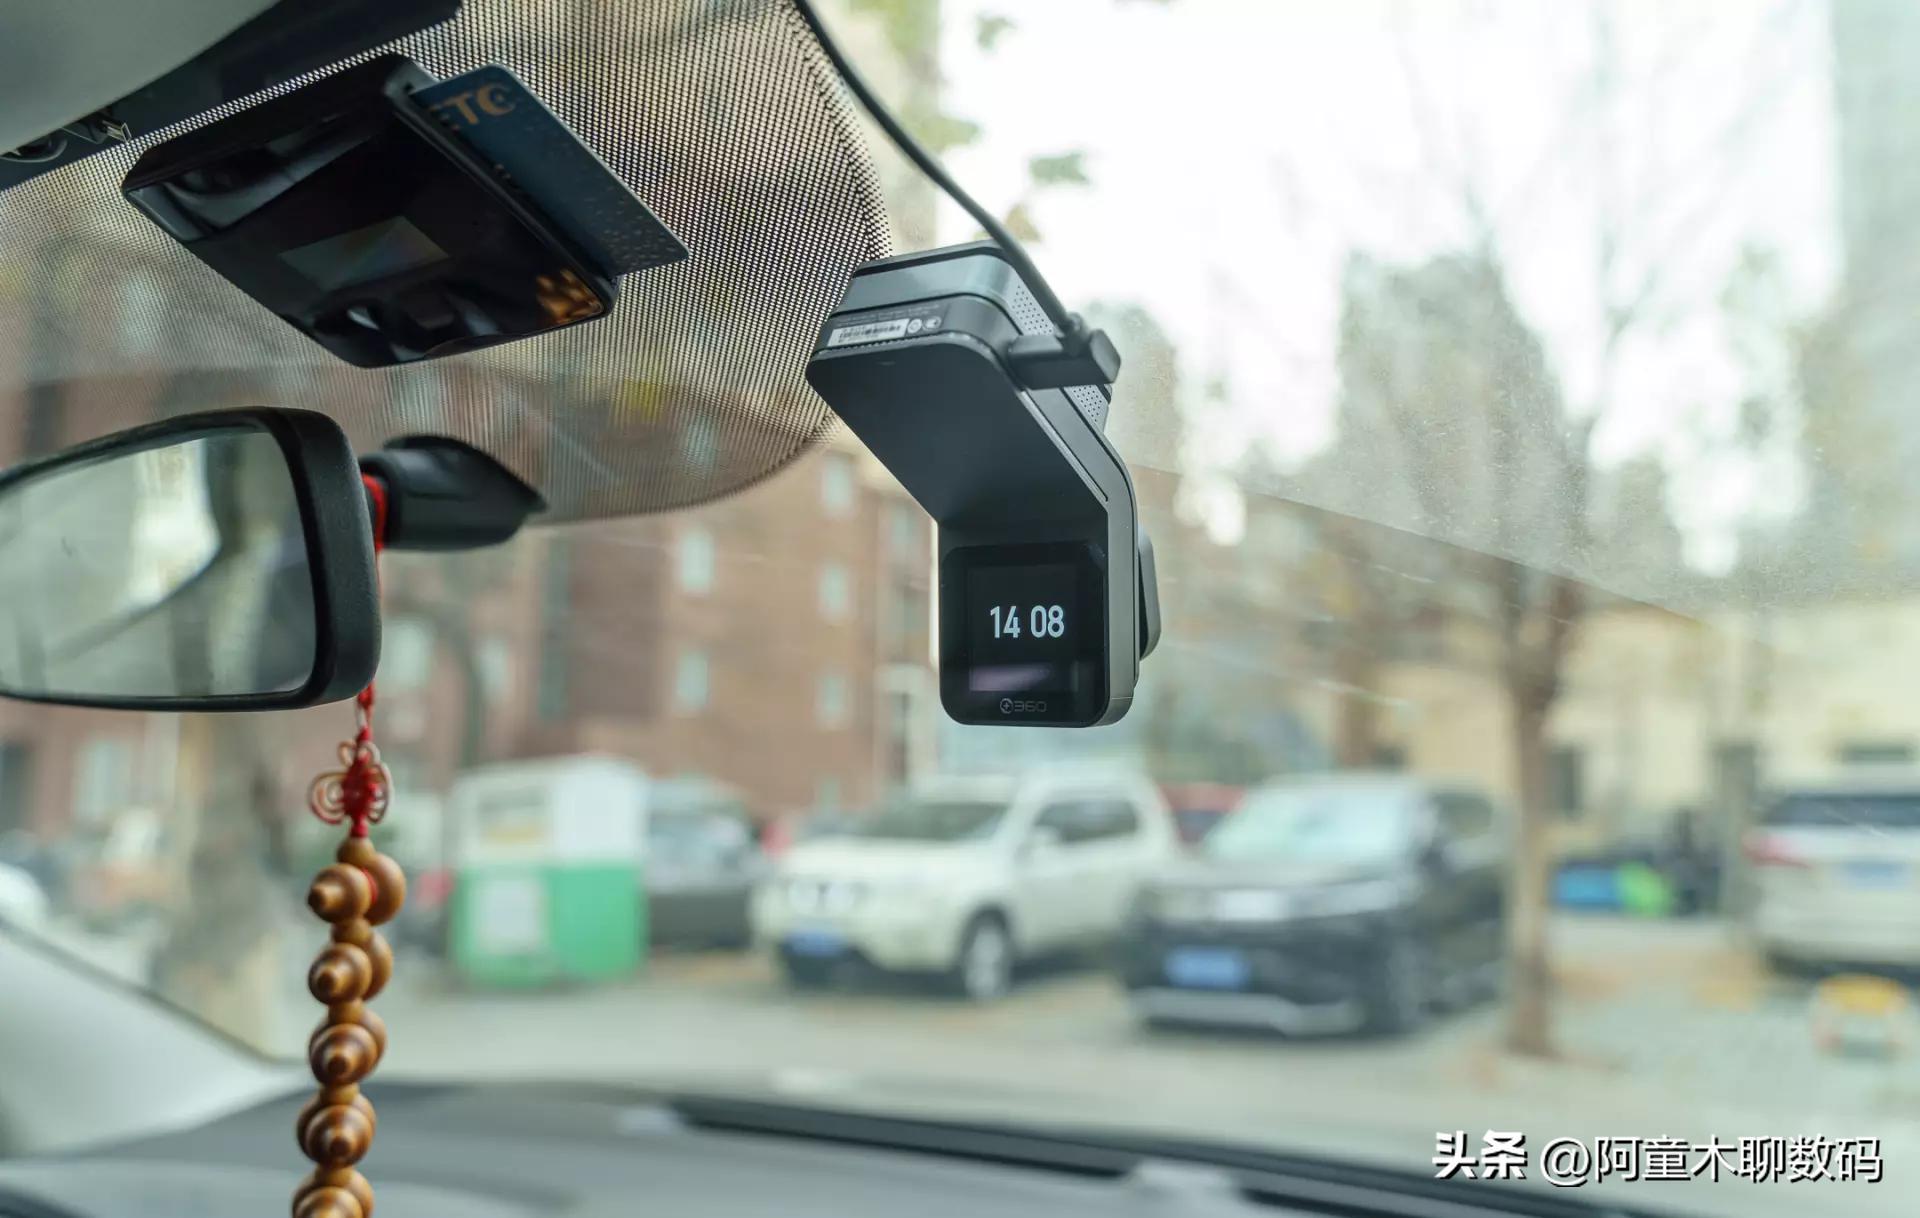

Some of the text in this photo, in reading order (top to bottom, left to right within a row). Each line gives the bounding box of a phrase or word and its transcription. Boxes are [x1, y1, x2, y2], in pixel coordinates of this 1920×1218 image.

[990, 605, 1065, 638] 14 08
[1013, 699, 1047, 713] 360
